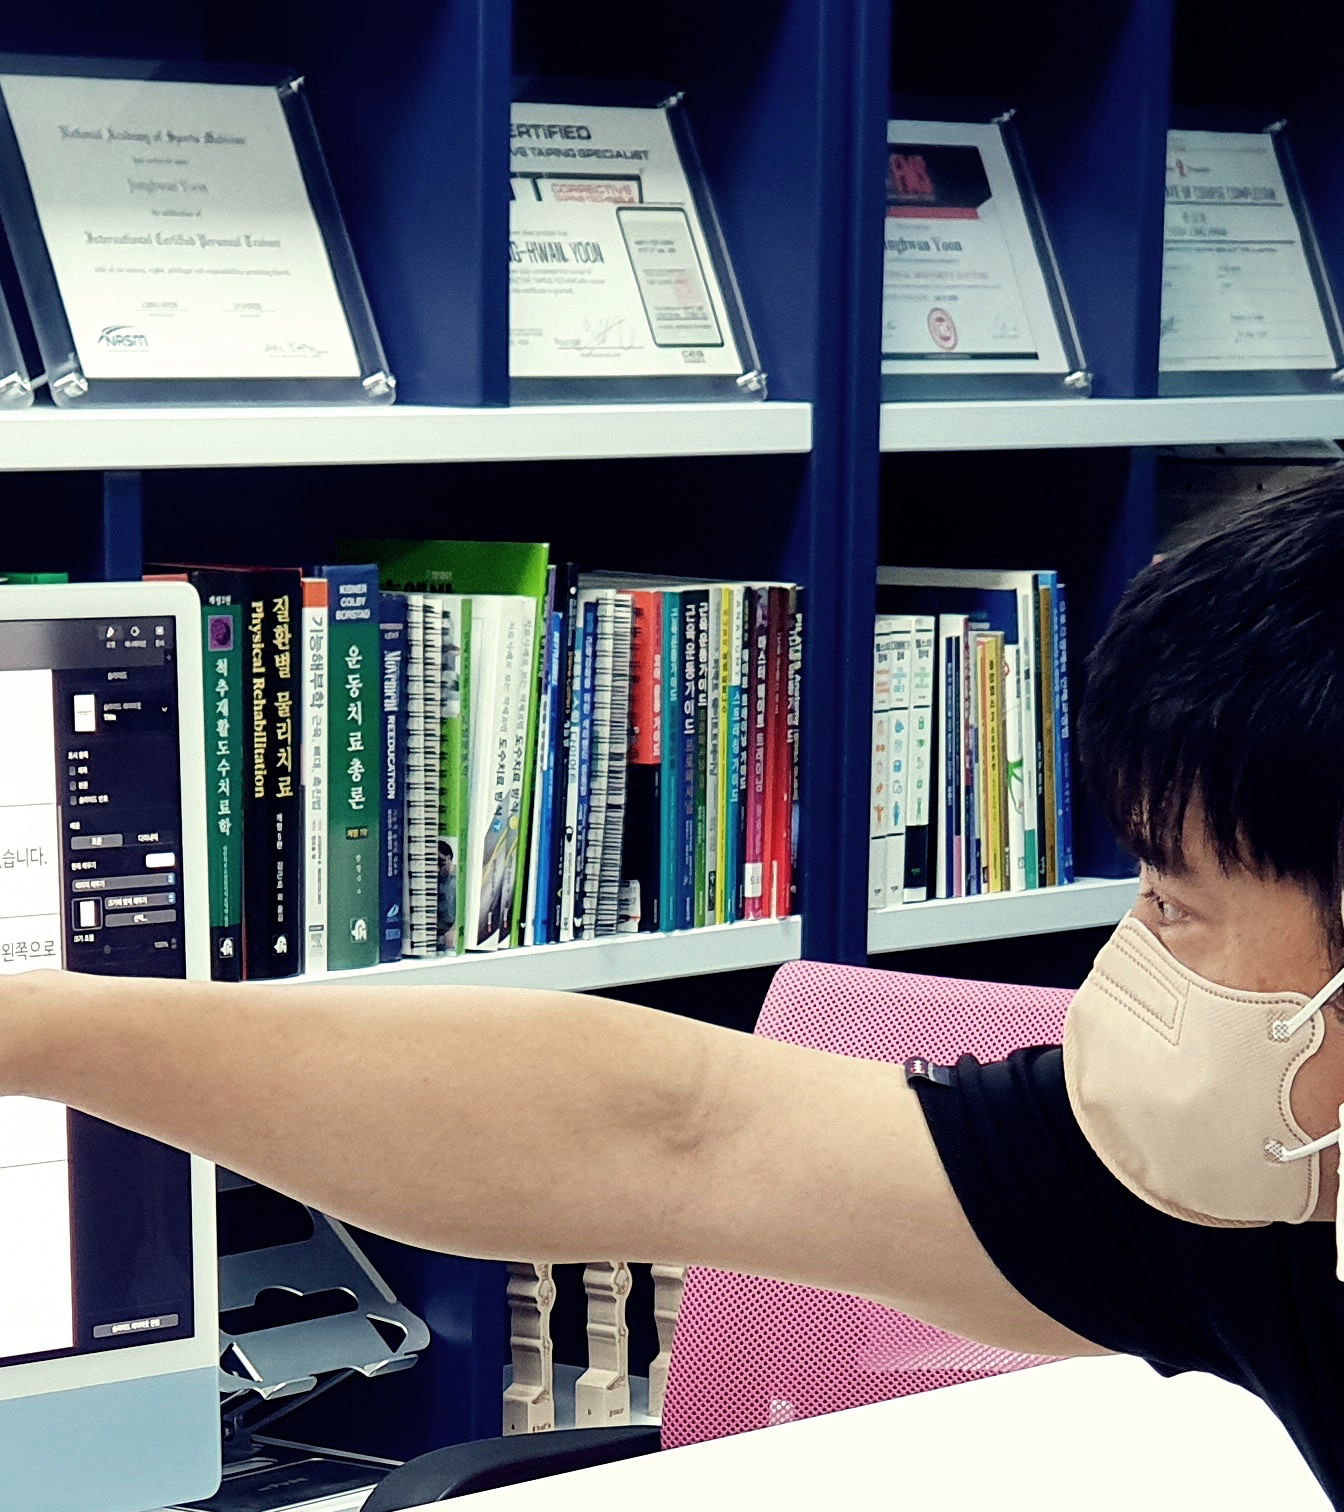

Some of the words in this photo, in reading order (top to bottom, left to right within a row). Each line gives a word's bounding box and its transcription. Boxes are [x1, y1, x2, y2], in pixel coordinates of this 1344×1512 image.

[249, 601, 266, 673] Physical
[309, 616, 324, 709] 기능해부학
[251, 677, 268, 799] Rehabilitation
[385, 715, 397, 800] REEDUCATION
[1, 939, 56, 962] 왼쪽으로
